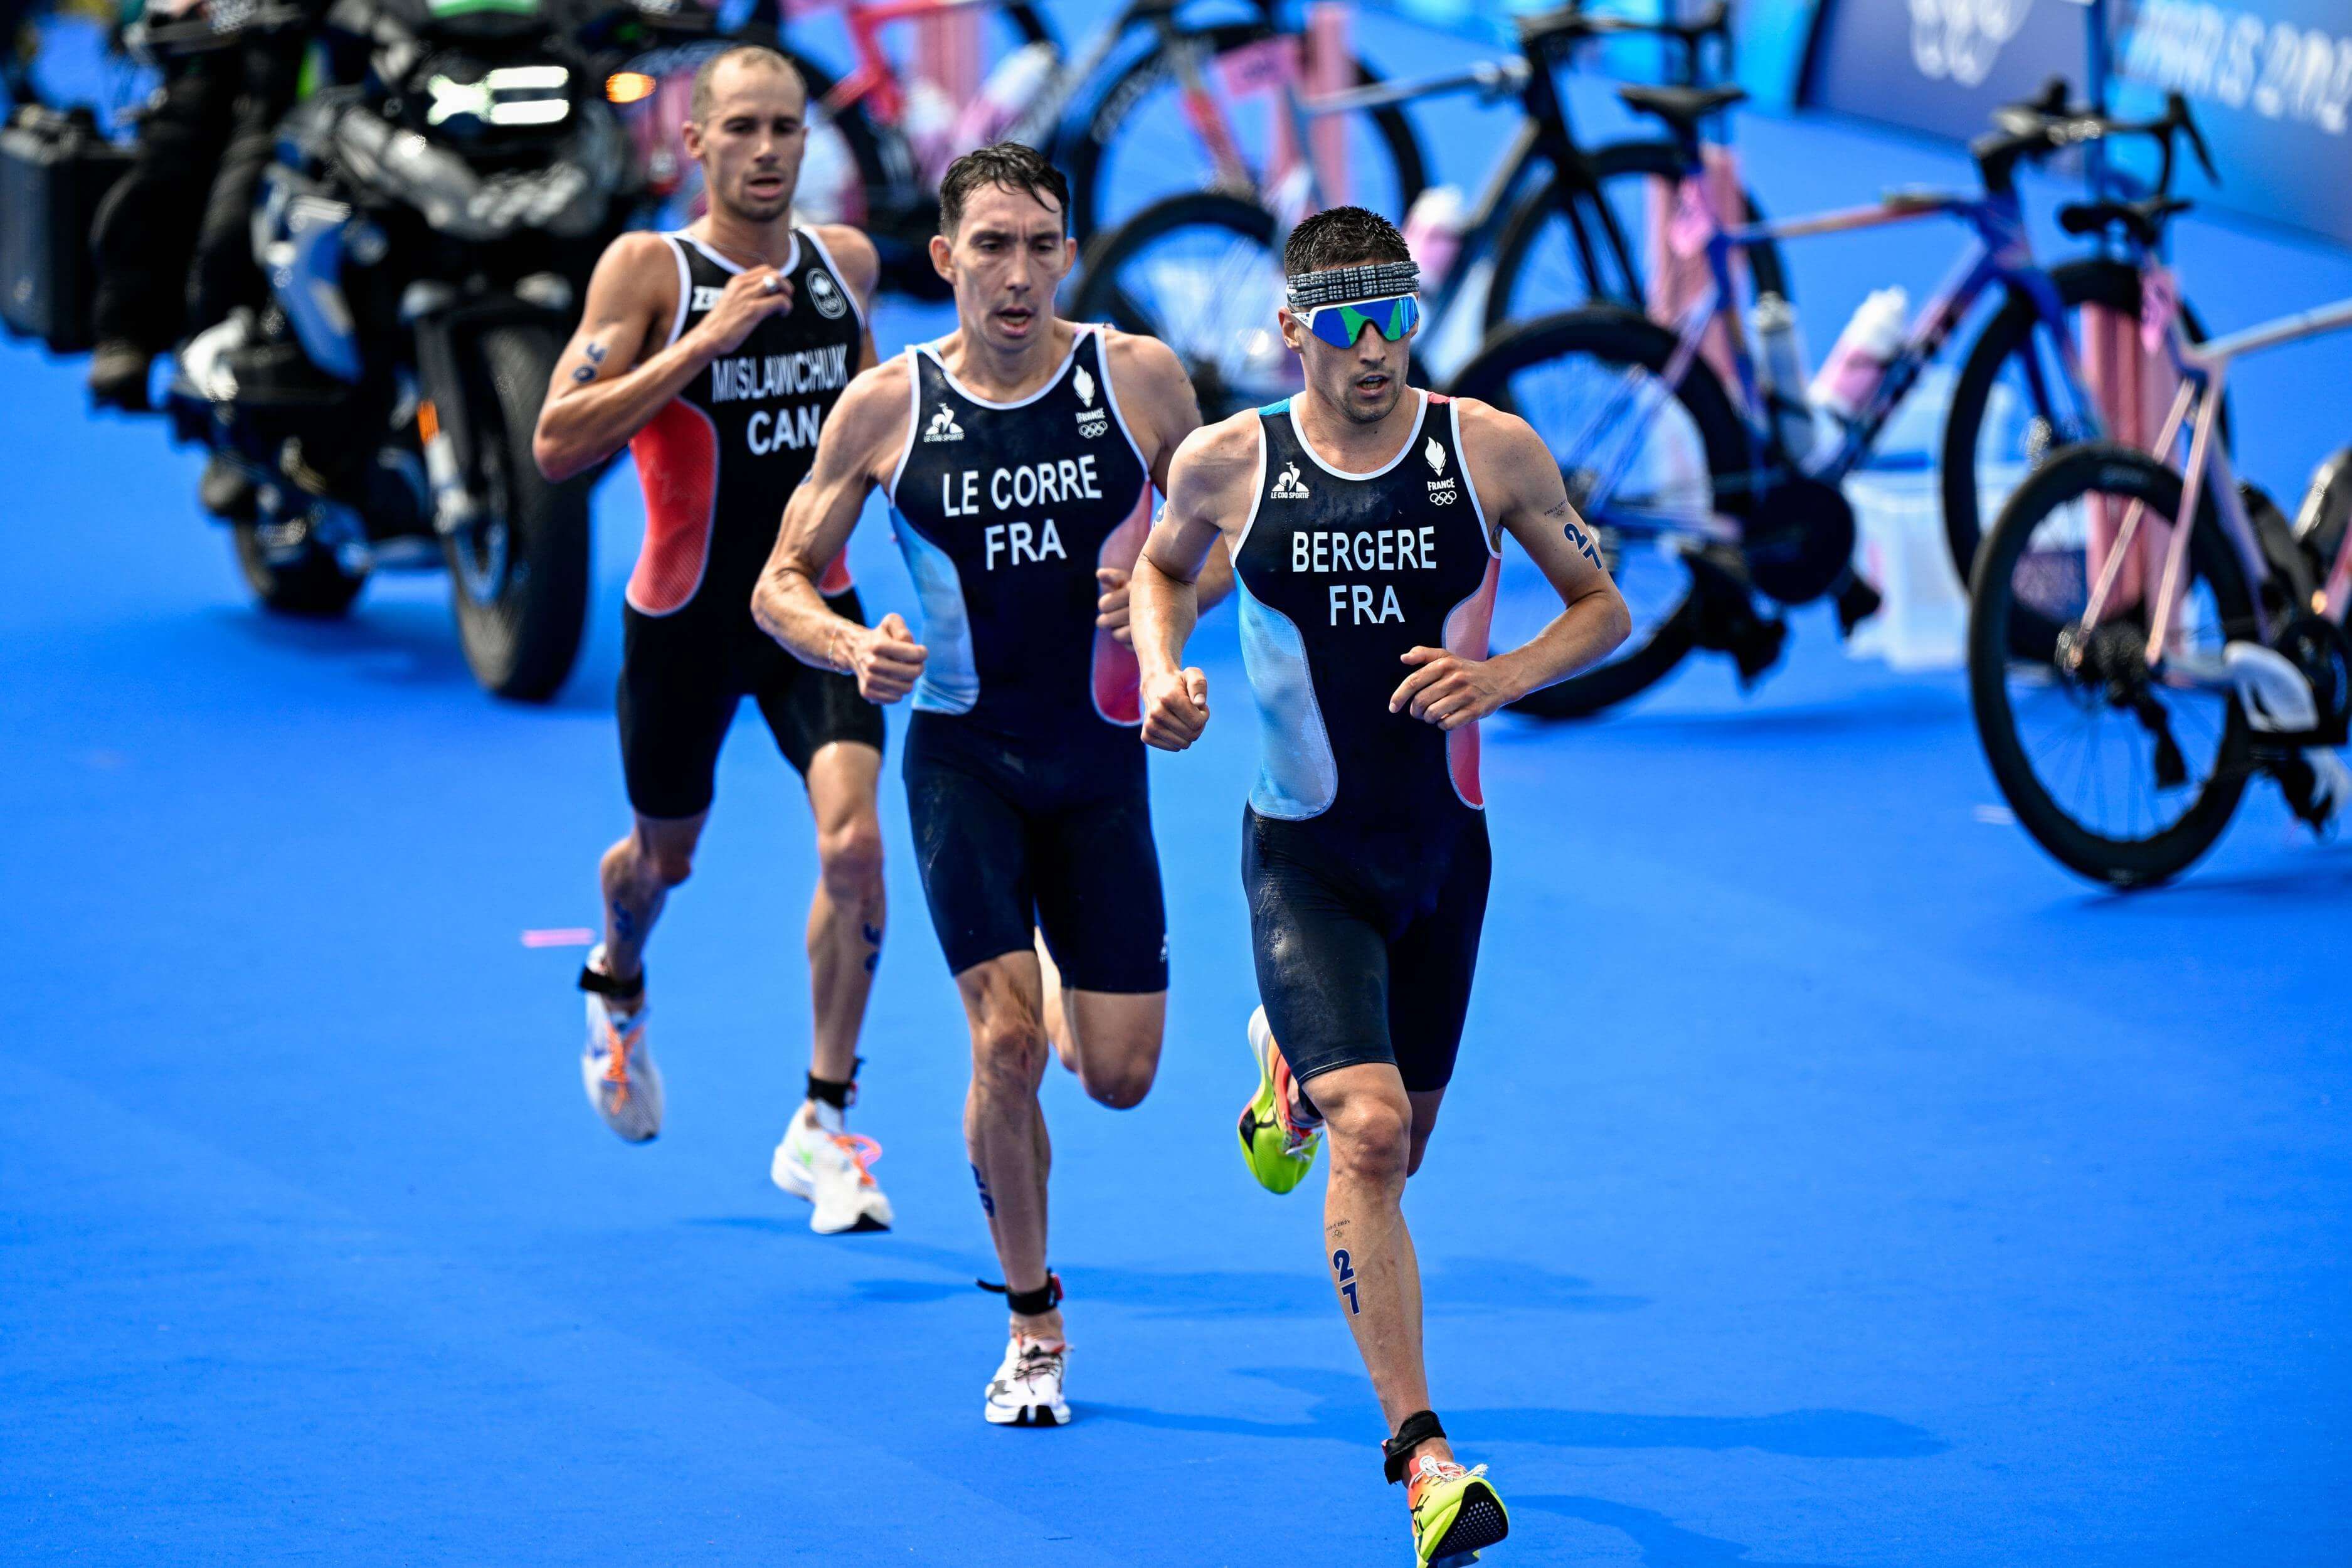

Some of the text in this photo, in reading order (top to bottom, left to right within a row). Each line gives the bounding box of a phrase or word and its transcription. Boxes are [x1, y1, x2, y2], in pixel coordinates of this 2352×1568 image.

[712, 343, 848, 403] MISLAWCHUK
[747, 403, 820, 456] CAN
[943, 454, 1103, 517] LE CORRE
[1427, 477, 1456, 491] FRANCE
[985, 519, 1067, 571] FRA
[1292, 526, 1437, 573] BERGERE
[1562, 522, 1603, 571] 27
[1329, 585, 1406, 627] FRA
[1332, 1248, 1360, 1316] 27
